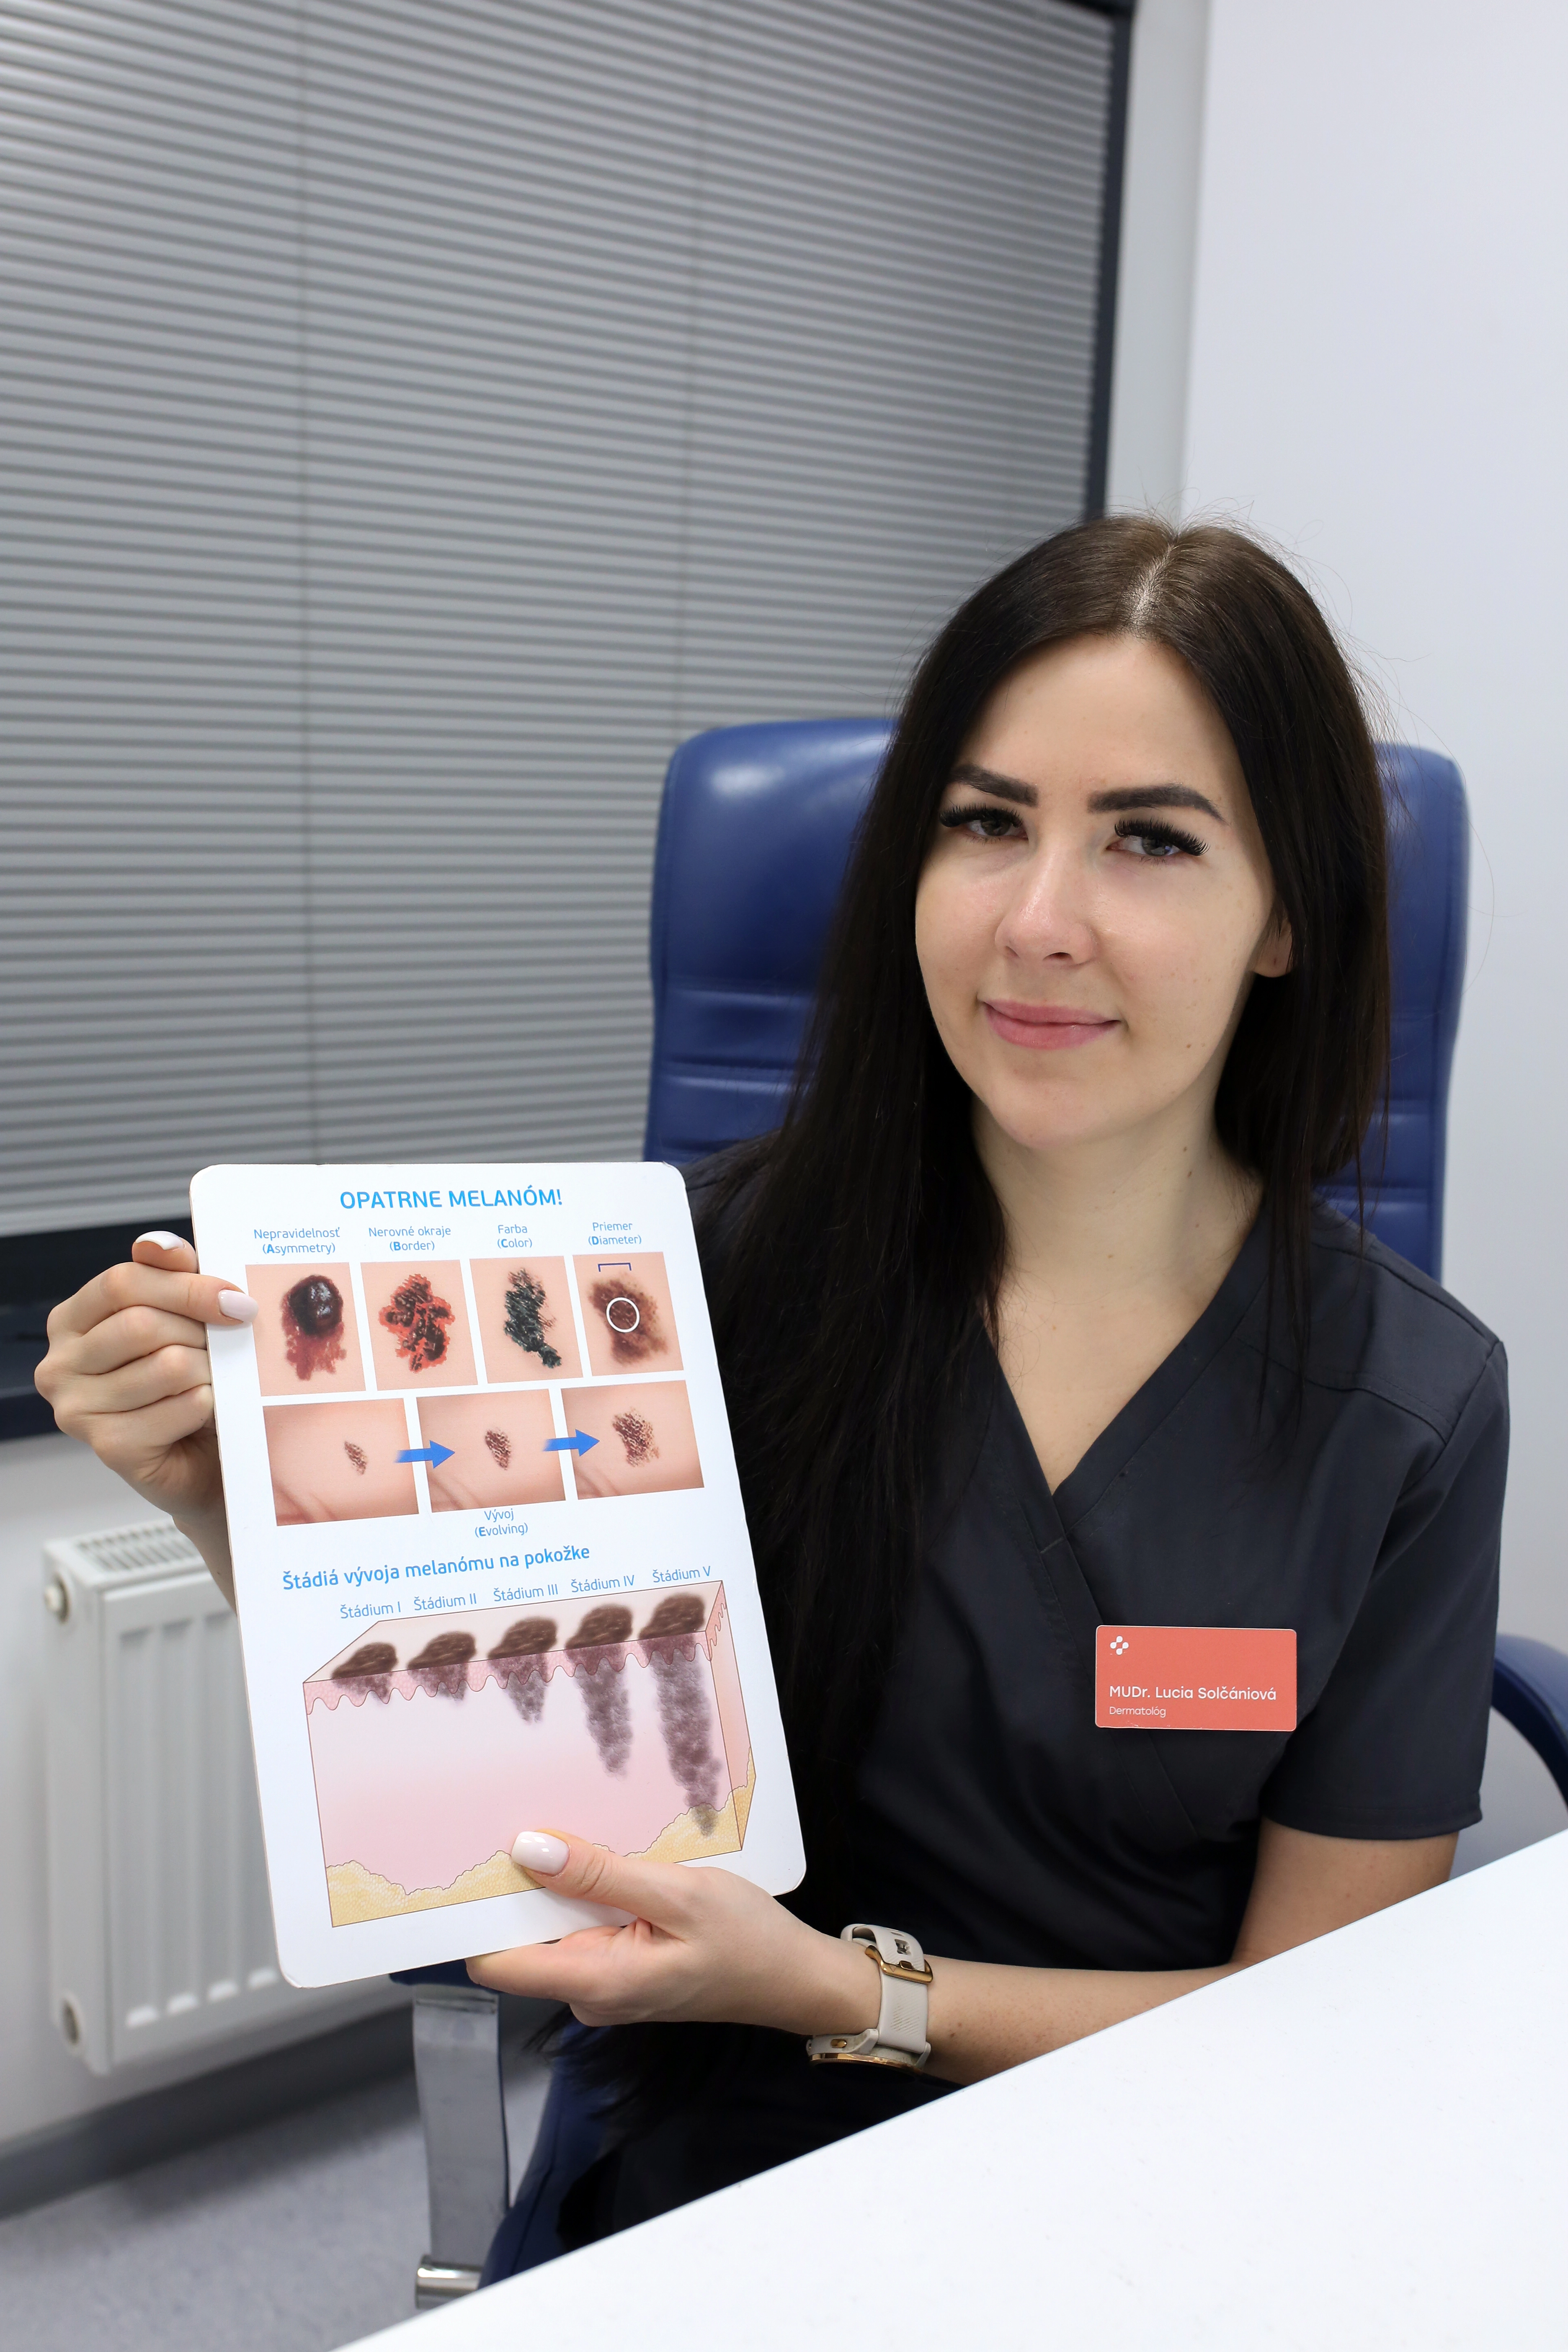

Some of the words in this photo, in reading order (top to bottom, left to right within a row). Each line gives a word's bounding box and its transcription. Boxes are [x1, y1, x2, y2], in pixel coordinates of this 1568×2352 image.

[340, 1190, 443, 1209] OPATRNE
[449, 1185, 563, 1207] MELANÓM!
[369, 1226, 415, 1237] Nerovné
[418, 1226, 451, 1238] okraje
[498, 1225, 528, 1234] Farba
[592, 1222, 633, 1231] Priemer
[254, 1227, 340, 1241] Nepravidelnosť
[588, 1235, 642, 1246] (Diameter)
[263, 1242, 336, 1256] (Asymmetry)
[390, 1241, 435, 1252] (Border)
[497, 1238, 533, 1249] (Color)
[484, 1508, 514, 1522] Vývoj
[475, 1521, 528, 1538] (Evolving)
[283, 1569, 339, 1590] Štádiá
[344, 1565, 400, 1587] vývoja
[405, 1556, 494, 1578] melanómu
[500, 1555, 520, 1568] na
[525, 1545, 590, 1569] pokožke
[653, 1569, 701, 1584] Štádium
[704, 1566, 712, 1577] V
[571, 1579, 621, 1593] Štádium
[624, 1575, 635, 1587] IV
[494, 1587, 545, 1602] Štádium
[548, 1584, 559, 1596] III
[414, 1596, 466, 1611] Štádium
[469, 1593, 477, 1605] II
[340, 1604, 394, 1619] Štádium
[397, 1601, 402, 1613] I
[1109, 1686, 1151, 1698] MUDr.
[1156, 1686, 1194, 1699] Lucia
[1198, 1686, 1276, 1701] Solčániová
[1109, 1706, 1167, 1718] Dermatológ
